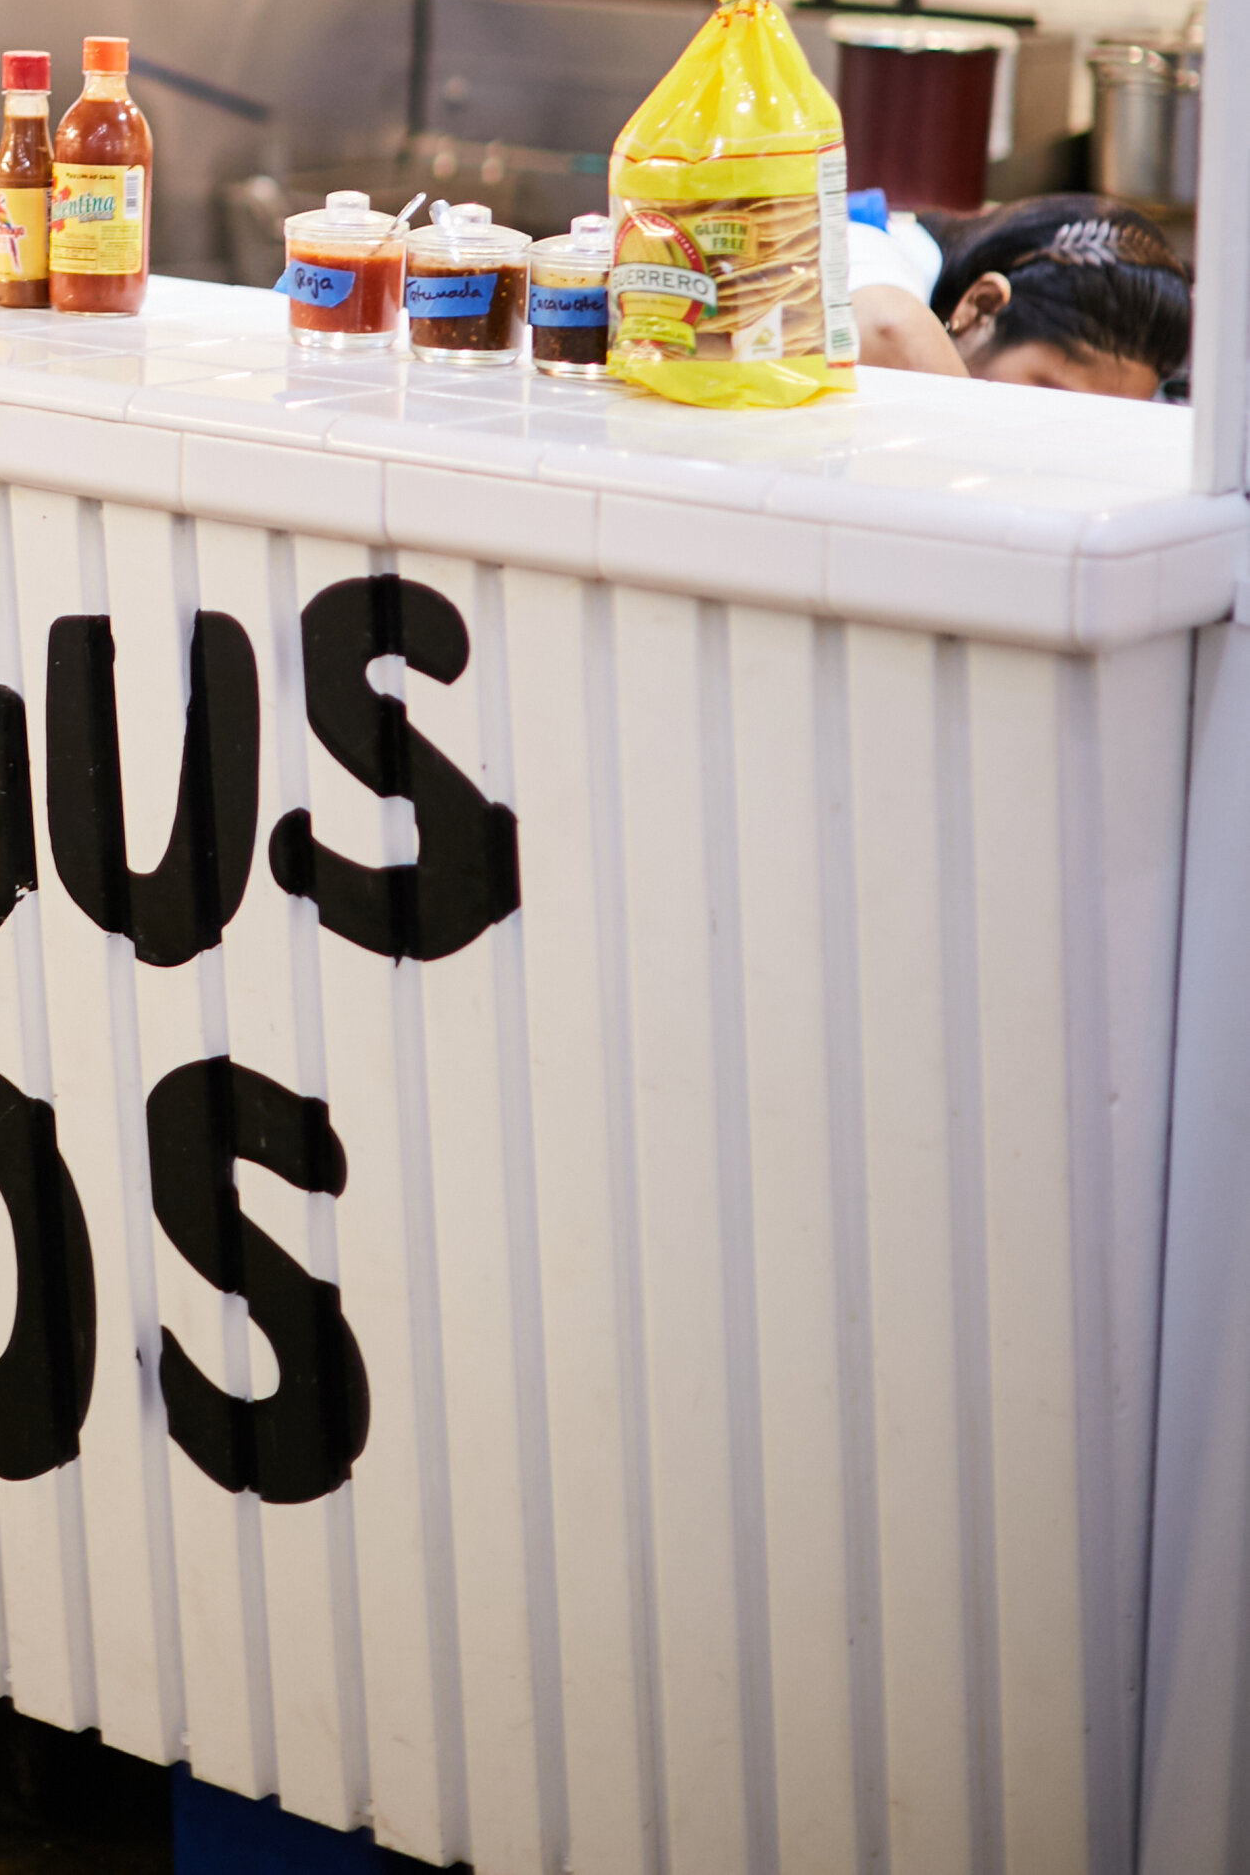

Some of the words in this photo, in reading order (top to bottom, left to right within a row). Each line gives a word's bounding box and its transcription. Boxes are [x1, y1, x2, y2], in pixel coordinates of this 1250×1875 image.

[694, 221, 747, 237] GLUTEN
[712, 236, 746, 251] FREE
[612, 268, 710, 296] GUERRERO
